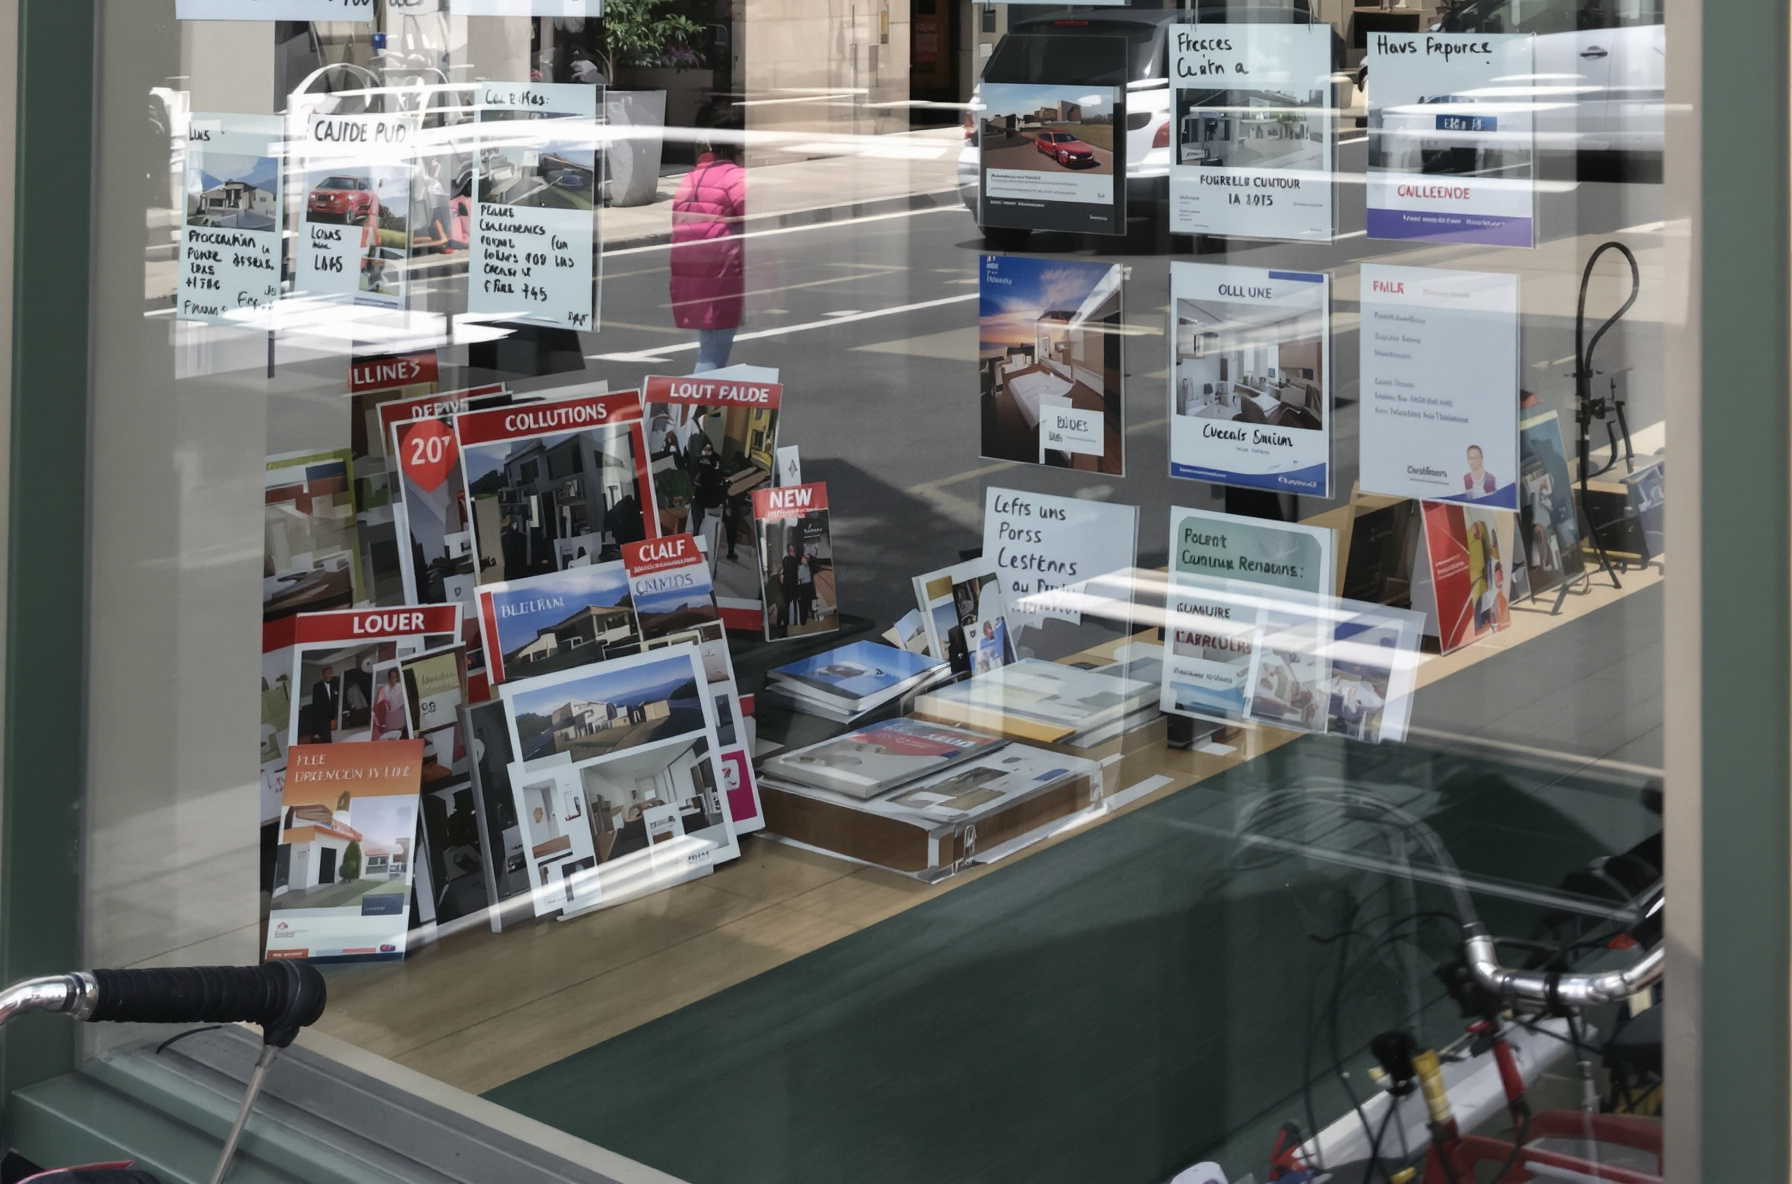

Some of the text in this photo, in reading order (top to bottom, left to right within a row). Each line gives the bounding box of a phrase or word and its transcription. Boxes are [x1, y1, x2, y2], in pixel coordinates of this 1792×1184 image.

[669, 382, 715, 399] LOUT
[504, 402, 608, 433] COLLUTIONS
[768, 487, 813, 509] NEW
[351, 612, 426, 635] LOUER
